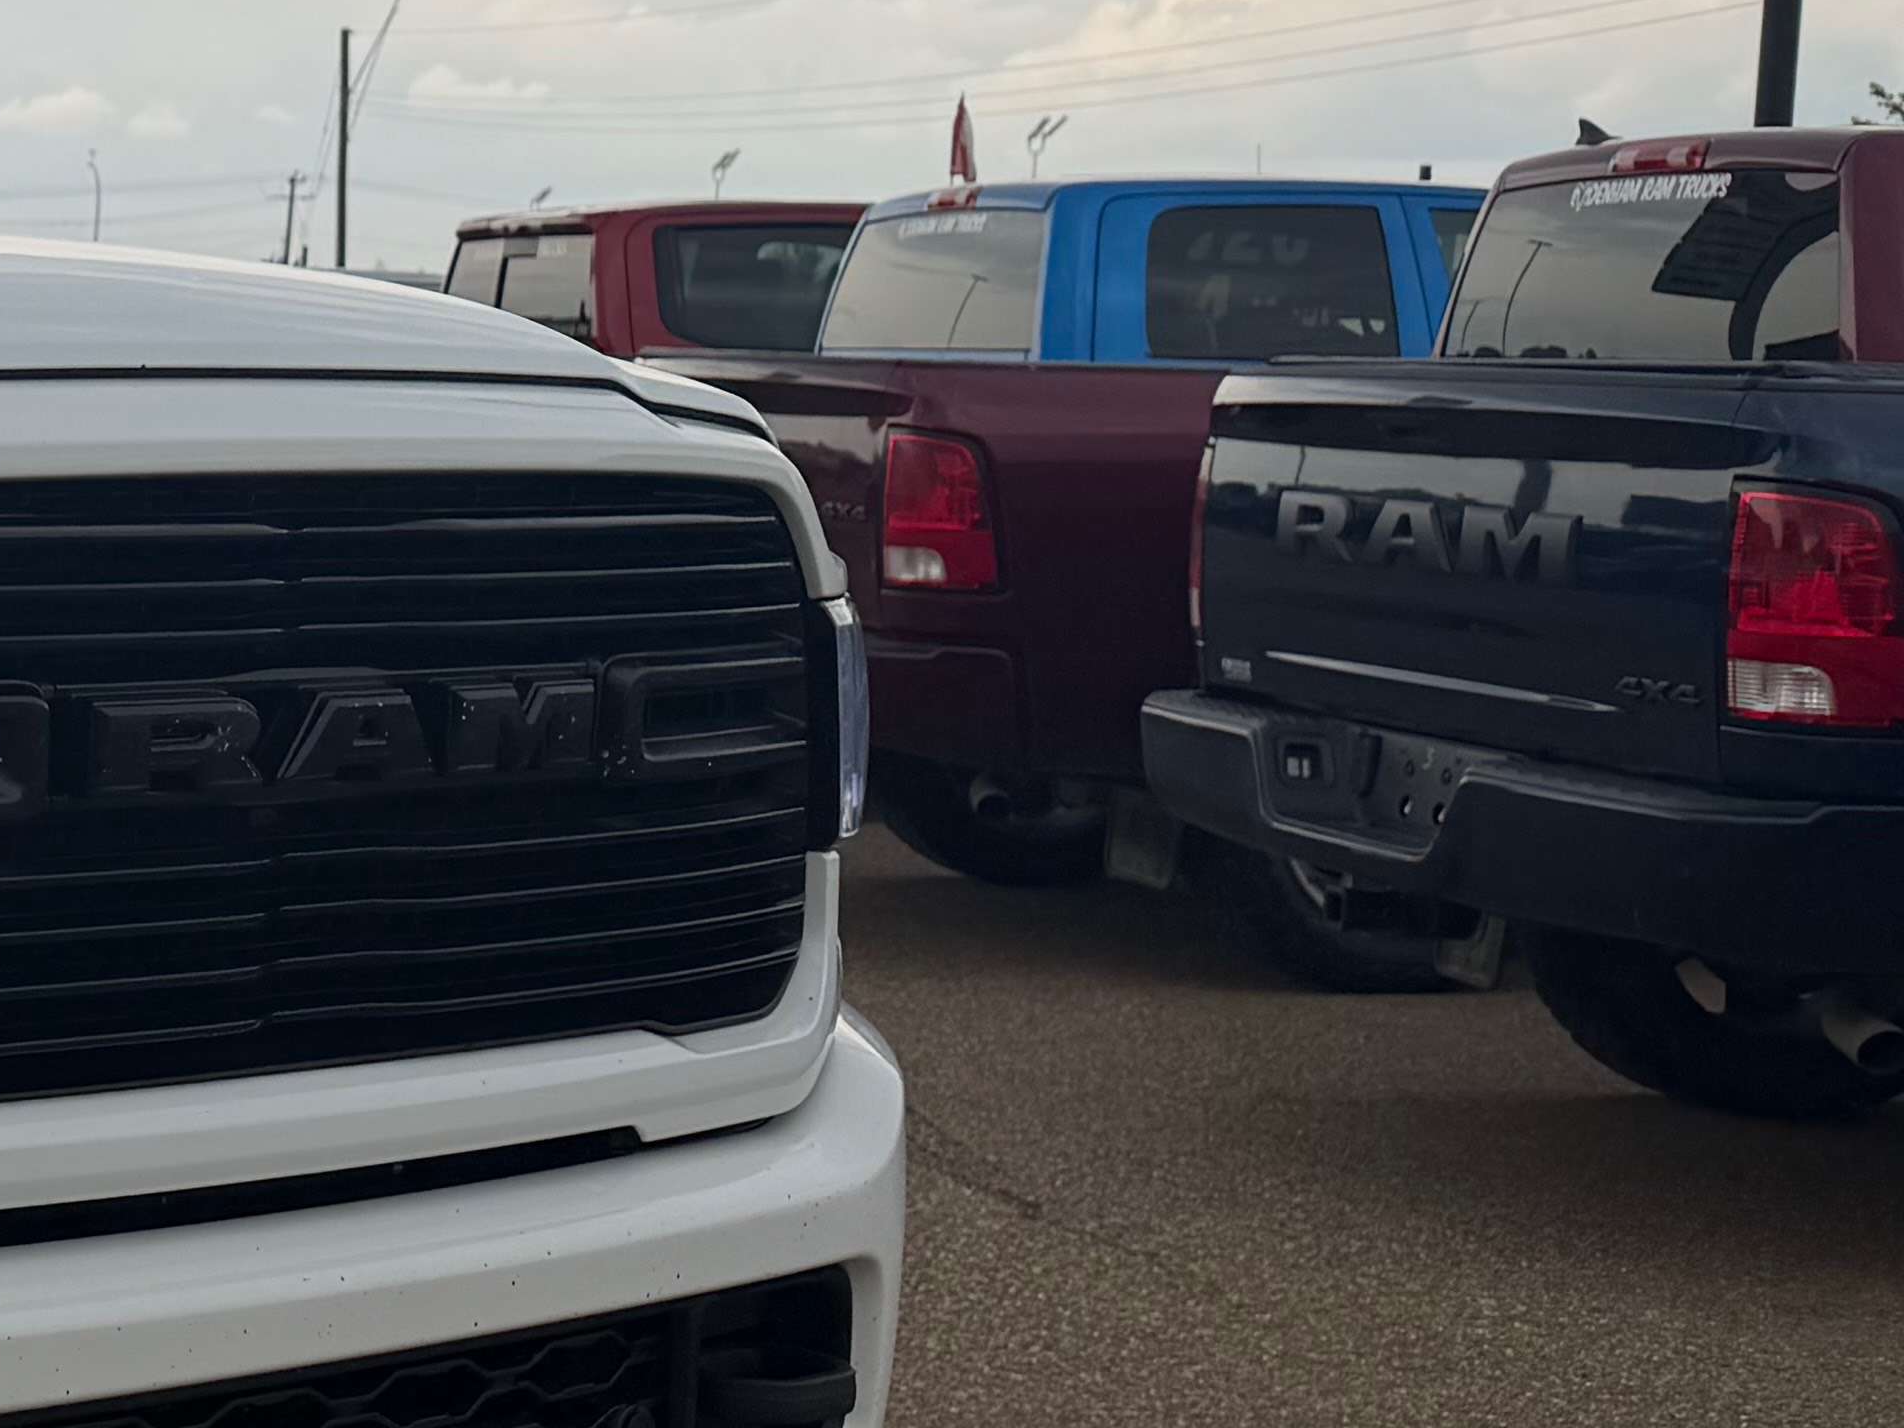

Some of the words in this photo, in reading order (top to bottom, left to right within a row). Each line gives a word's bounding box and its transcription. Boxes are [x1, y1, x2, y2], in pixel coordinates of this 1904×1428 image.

[1641, 174, 1677, 201] RAM
[1676, 172, 1733, 199] TRUCKS
[1275, 489, 1584, 586] RAM
[1614, 676, 1703, 707] 4X4
[89, 670, 596, 792] RAM
